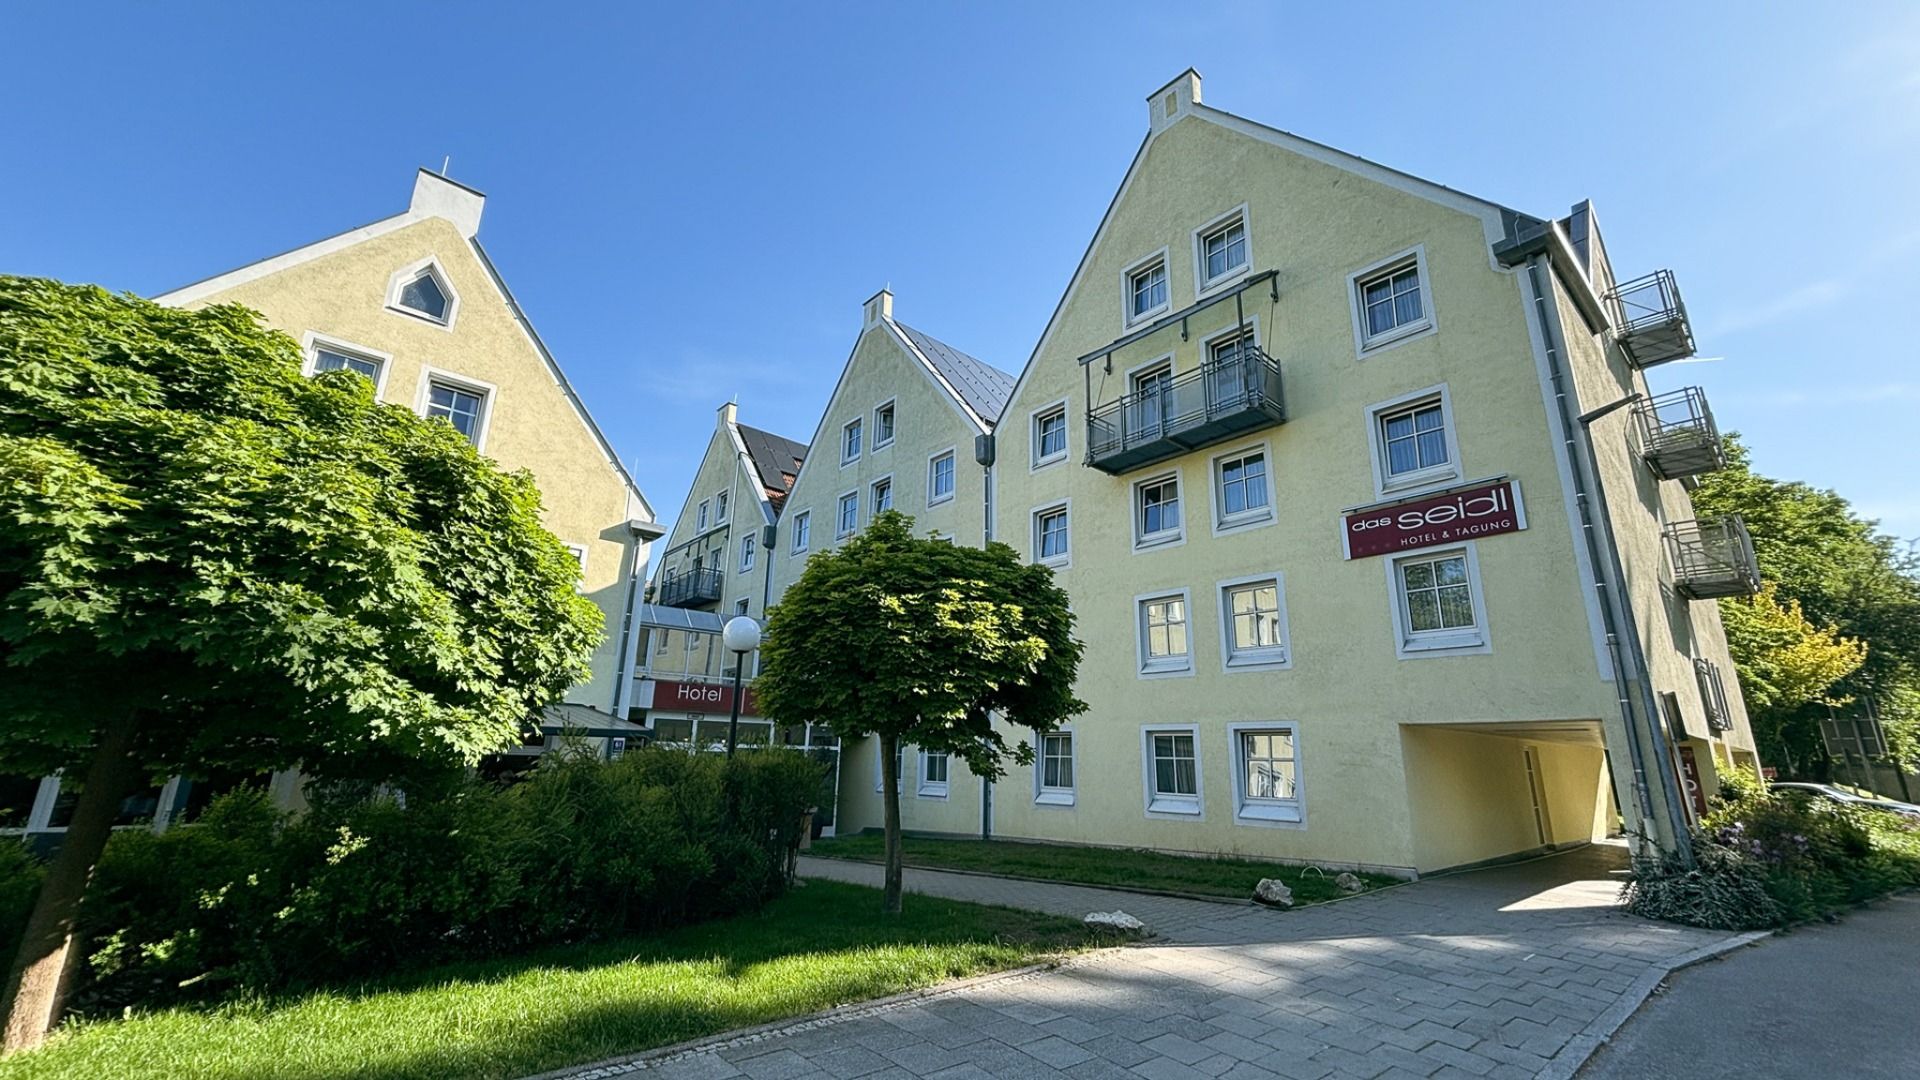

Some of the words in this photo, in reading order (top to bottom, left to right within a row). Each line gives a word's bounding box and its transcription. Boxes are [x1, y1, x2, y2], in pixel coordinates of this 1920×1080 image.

[1352, 517, 1392, 532] das
[1397, 487, 1508, 530] seidl
[1400, 533, 1437, 546] HOTEL
[1442, 530, 1450, 539] &
[1455, 519, 1511, 537] TAGUNG
[678, 684, 722, 701] Hotel
